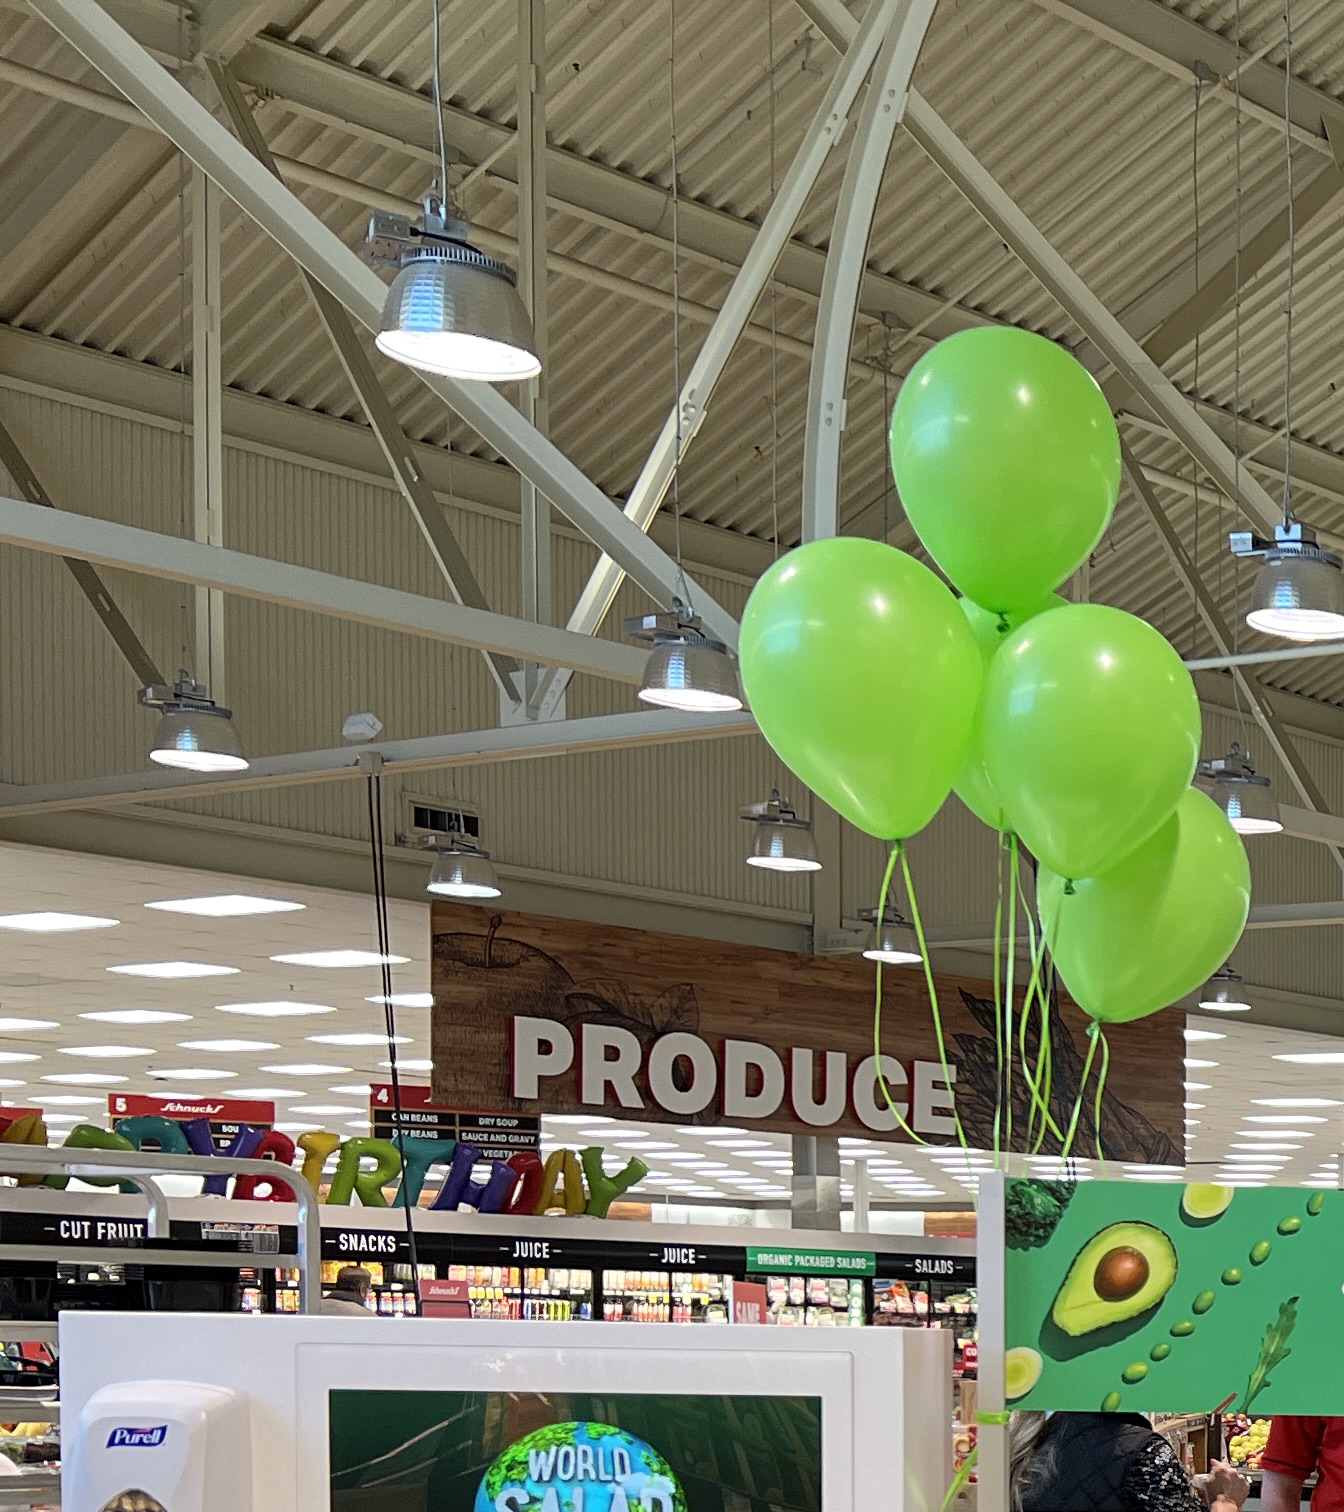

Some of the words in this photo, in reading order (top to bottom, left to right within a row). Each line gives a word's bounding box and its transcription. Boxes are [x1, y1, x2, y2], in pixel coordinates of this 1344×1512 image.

[511, 1015, 957, 1135] PRODUCE
[377, 1088, 389, 1103] 4
[115, 1098, 127, 1112] 5
[160, 1102, 225, 1114] Schnucks
[411, 1113, 439, 1124] BEANS
[478, 1117, 495, 1126] DRY
[410, 1129, 439, 1140] BEANS
[60, 1220, 91, 1240] CUT
[339, 1233, 397, 1253] SNACKS
[511, 1240, 551, 1260] JUICE
[660, 1247, 696, 1265] JUICE
[757, 1253, 793, 1267] ORGANIC
[794, 1255, 835, 1268] PACKAGED
[836, 1257, 867, 1270] SALADS
[914, 1259, 954, 1274] SALADS
[528, 1444, 632, 1484] WORLD
